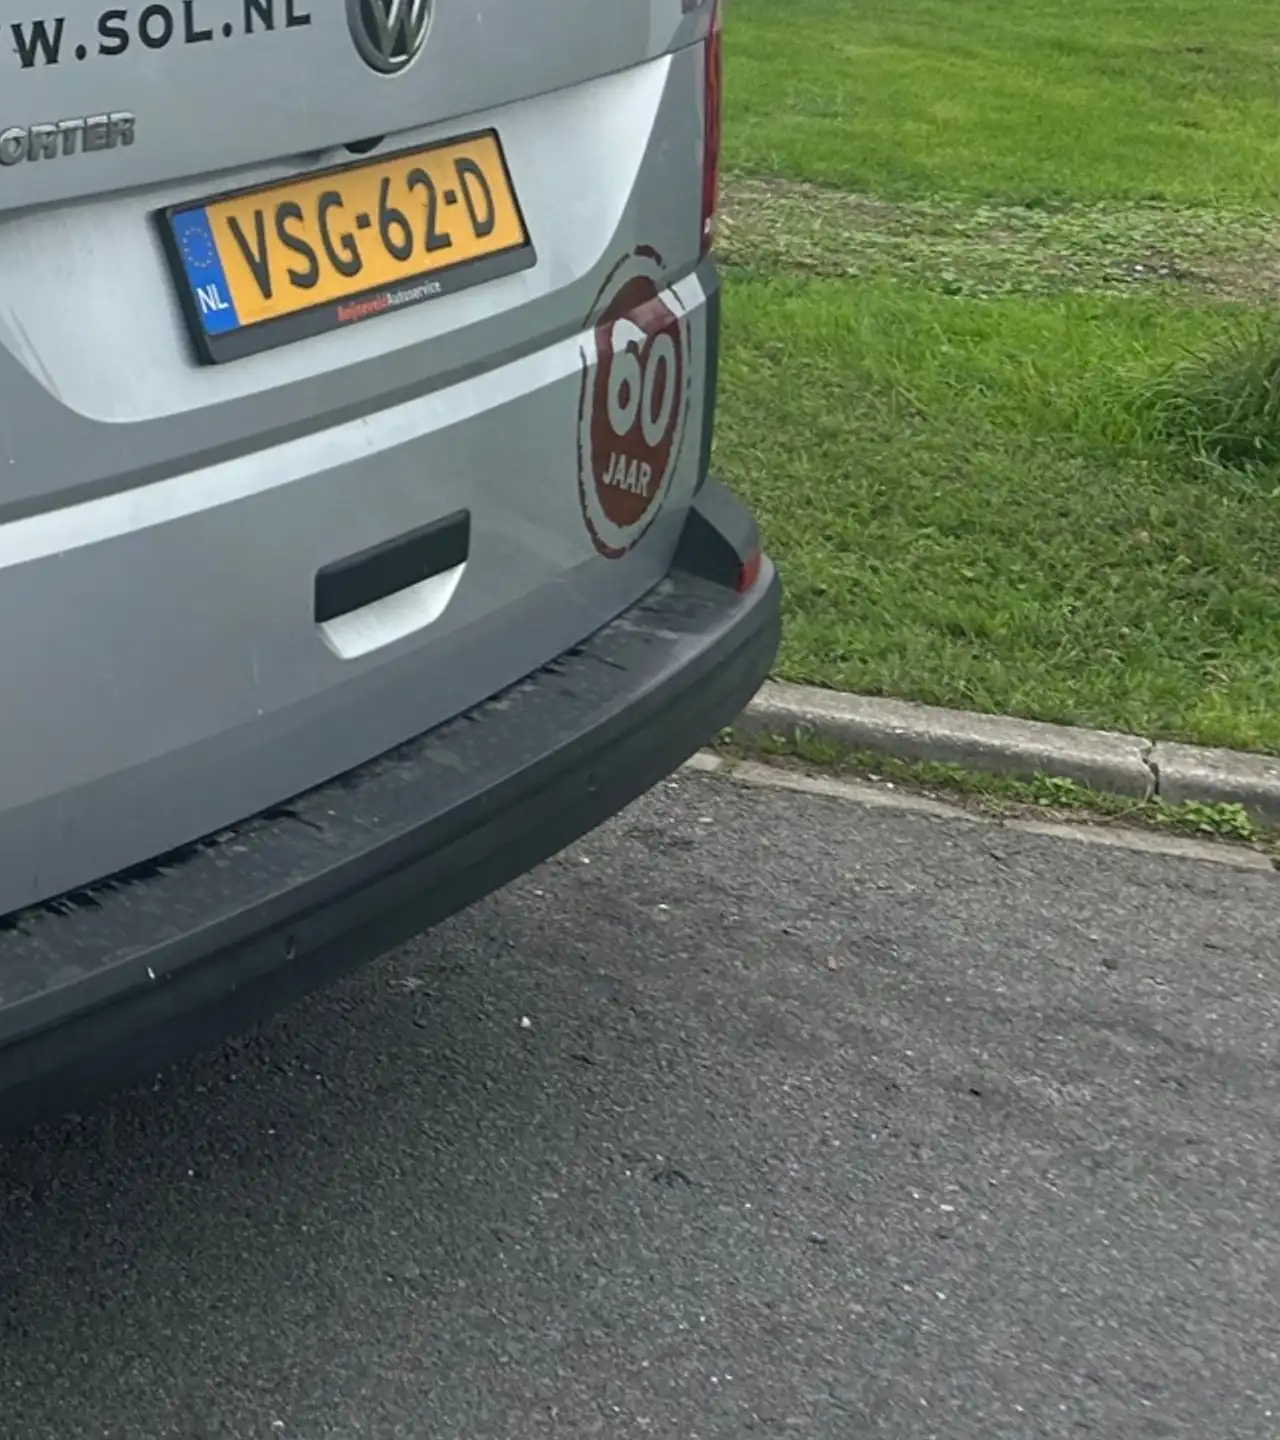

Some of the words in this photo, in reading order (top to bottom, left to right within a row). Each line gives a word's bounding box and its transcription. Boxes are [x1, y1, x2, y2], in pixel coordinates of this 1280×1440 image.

[226, 156, 496, 301] VSG-62-D
[196, 282, 229, 314] NL
[607, 317, 676, 448] 60
[602, 452, 653, 498] JAAR
